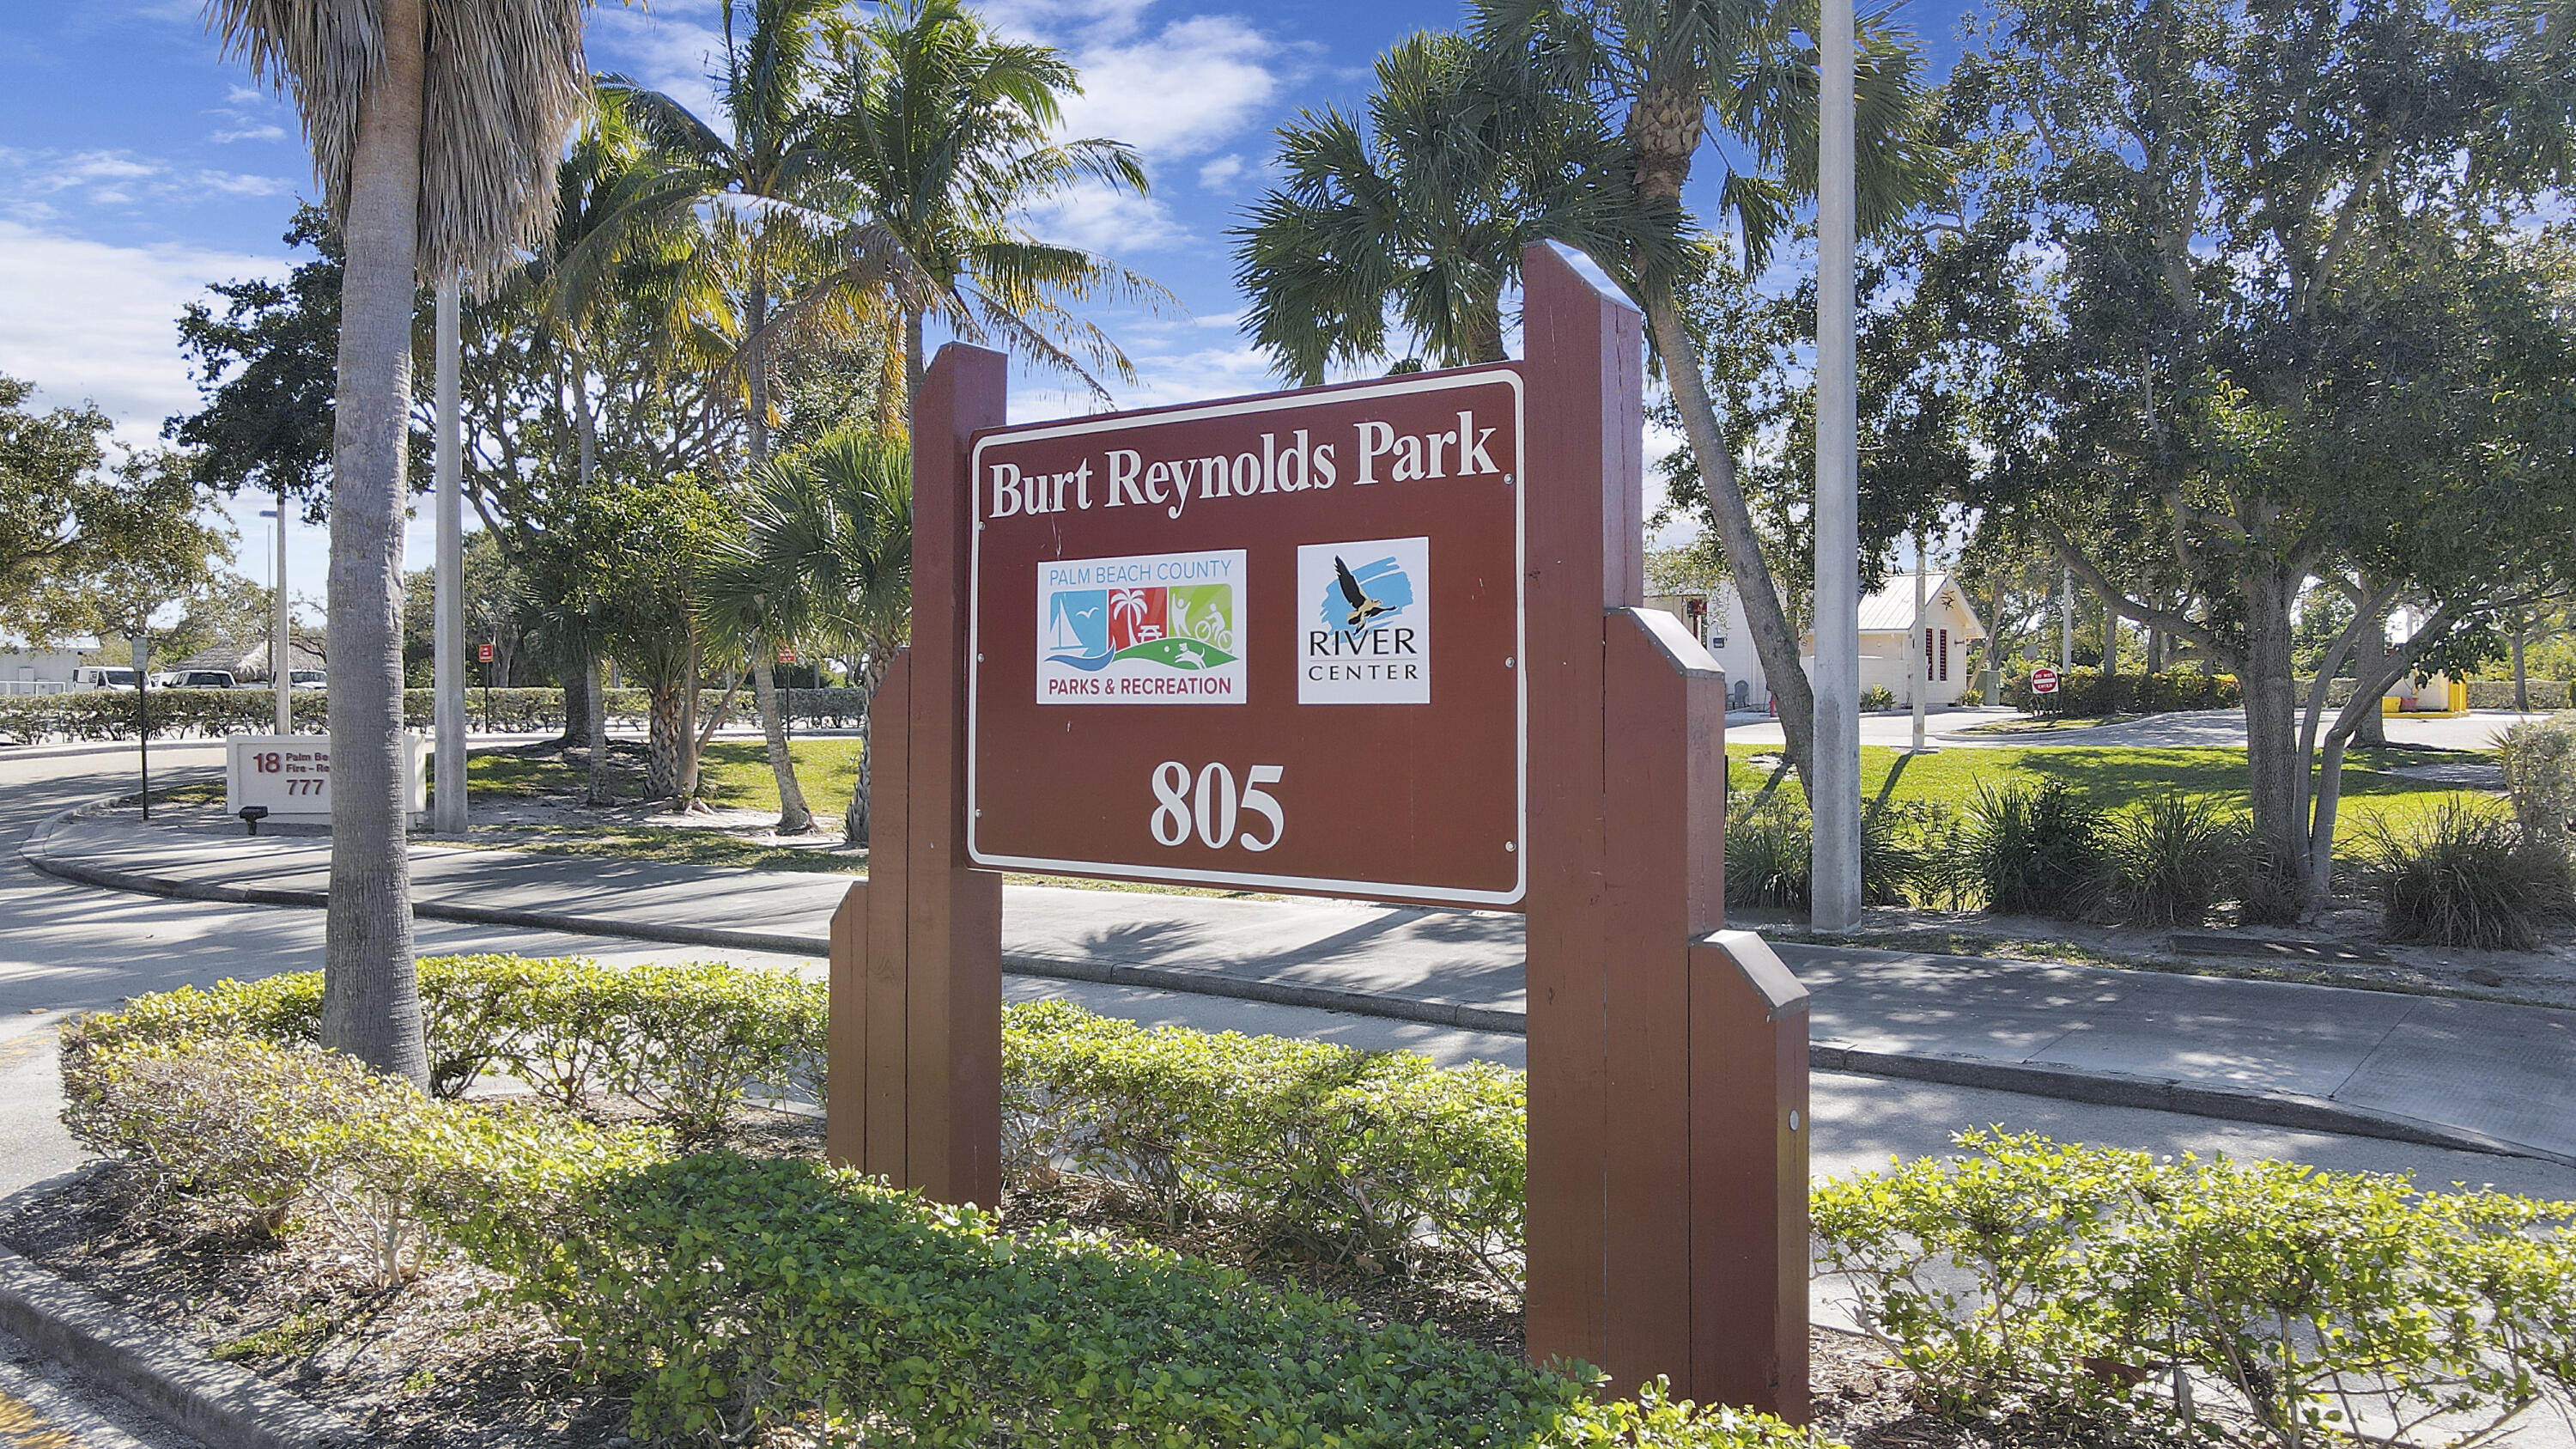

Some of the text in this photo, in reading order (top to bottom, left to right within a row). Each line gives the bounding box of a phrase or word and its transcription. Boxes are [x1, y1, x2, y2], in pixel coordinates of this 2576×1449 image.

[988, 411, 1501, 520] Burt Reynolds Park
[1049, 559, 1232, 586] PALM BEACH COUNTY
[1309, 628, 1417, 656] RIVER
[1308, 664, 1419, 681] CENTER
[1048, 677, 1231, 695] PARKS & RECREATION
[252, 752, 281, 774] 18
[285, 752, 311, 762] Palm
[285, 764, 307, 773] Fire
[285, 779, 325, 795] 777
[1150, 761, 1285, 852] 805
